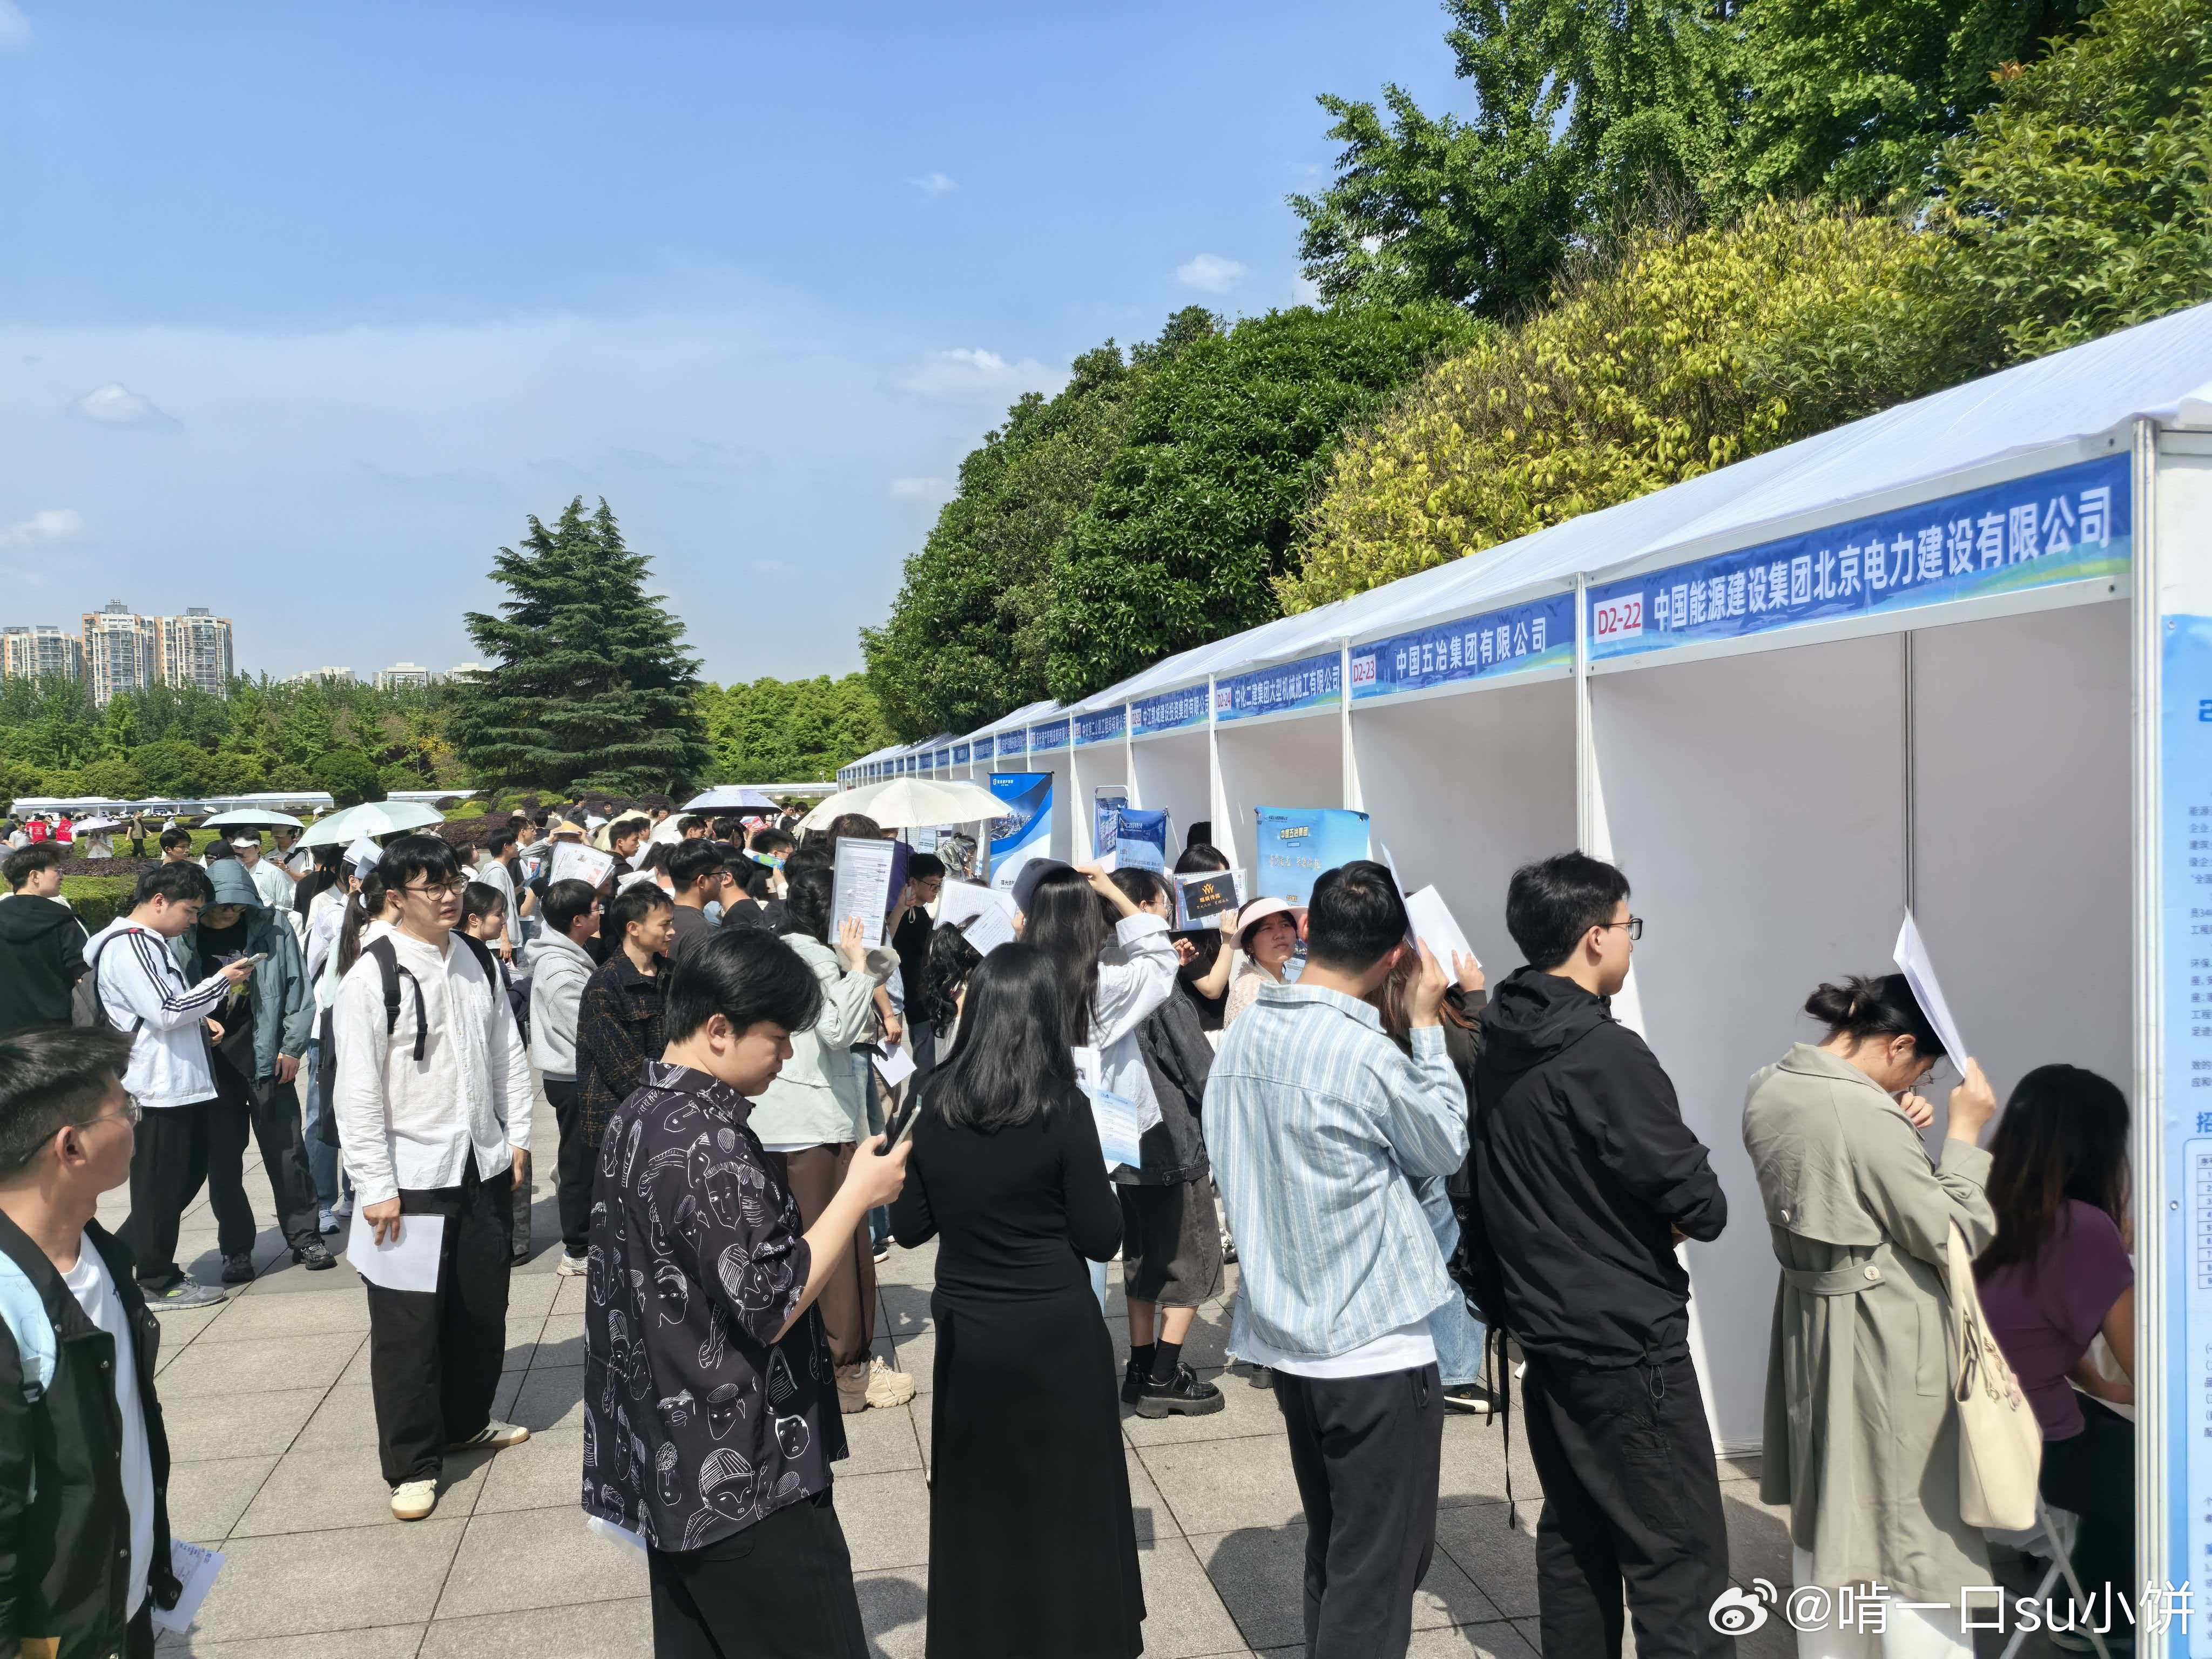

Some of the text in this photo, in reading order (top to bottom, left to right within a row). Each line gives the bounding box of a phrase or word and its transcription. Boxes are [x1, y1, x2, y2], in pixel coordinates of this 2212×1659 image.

[1654, 487, 2111, 631] 中国能源建设集团北京电力建设有限公司
[1598, 602, 1641, 635] D2-22
[1397, 617, 1546, 677] 中国五冶集团有限公司
[1235, 666, 1340, 709] 中化二建集团大型机械施工有限公司
[1353, 660, 1374, 682] D2-23
